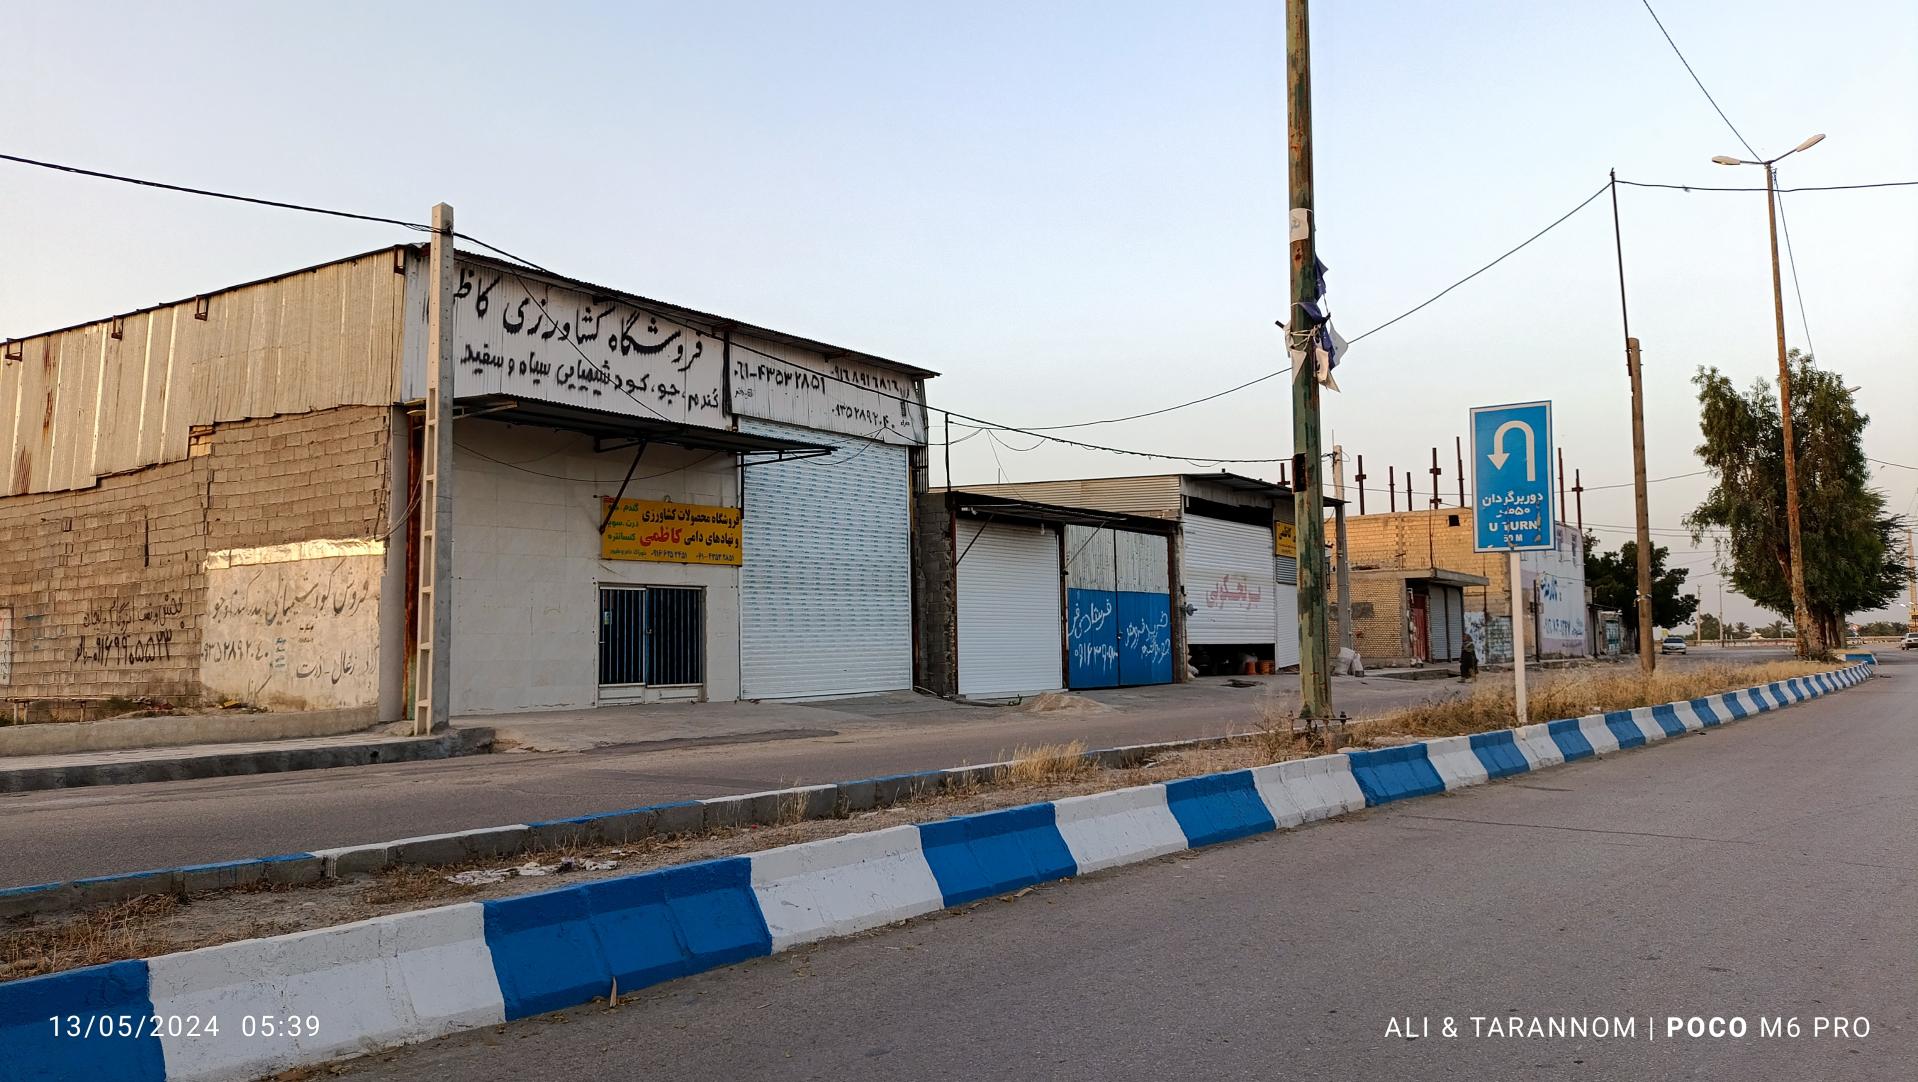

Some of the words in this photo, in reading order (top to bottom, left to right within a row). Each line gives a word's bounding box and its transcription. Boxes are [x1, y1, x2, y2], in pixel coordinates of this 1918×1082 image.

[502, 297, 617, 346] کشاورزی
[608, 311, 704, 373] فروشگاه
[460, 342, 504, 375] سفید
[507, 357, 515, 377] و
[519, 351, 552, 385] سیاه
[556, 359, 612, 396] شیمیایی
[614, 373, 651, 393] کود
[1481, 490, 1544, 508] دوربرگردان
[641, 507, 677, 523] کشاورزی
[677, 508, 710, 526] محصولات
[711, 512, 740, 529] فروشگاه
[639, 525, 683, 547] کاظمی
[1488, 522, 1498, 532] U
[1501, 520, 1538, 531] TURN
[683, 529, 704, 546] دامی
[1515, 533, 1523, 542] M
[313, 556, 348, 612] کود
[333, 566, 369, 617] فروش
